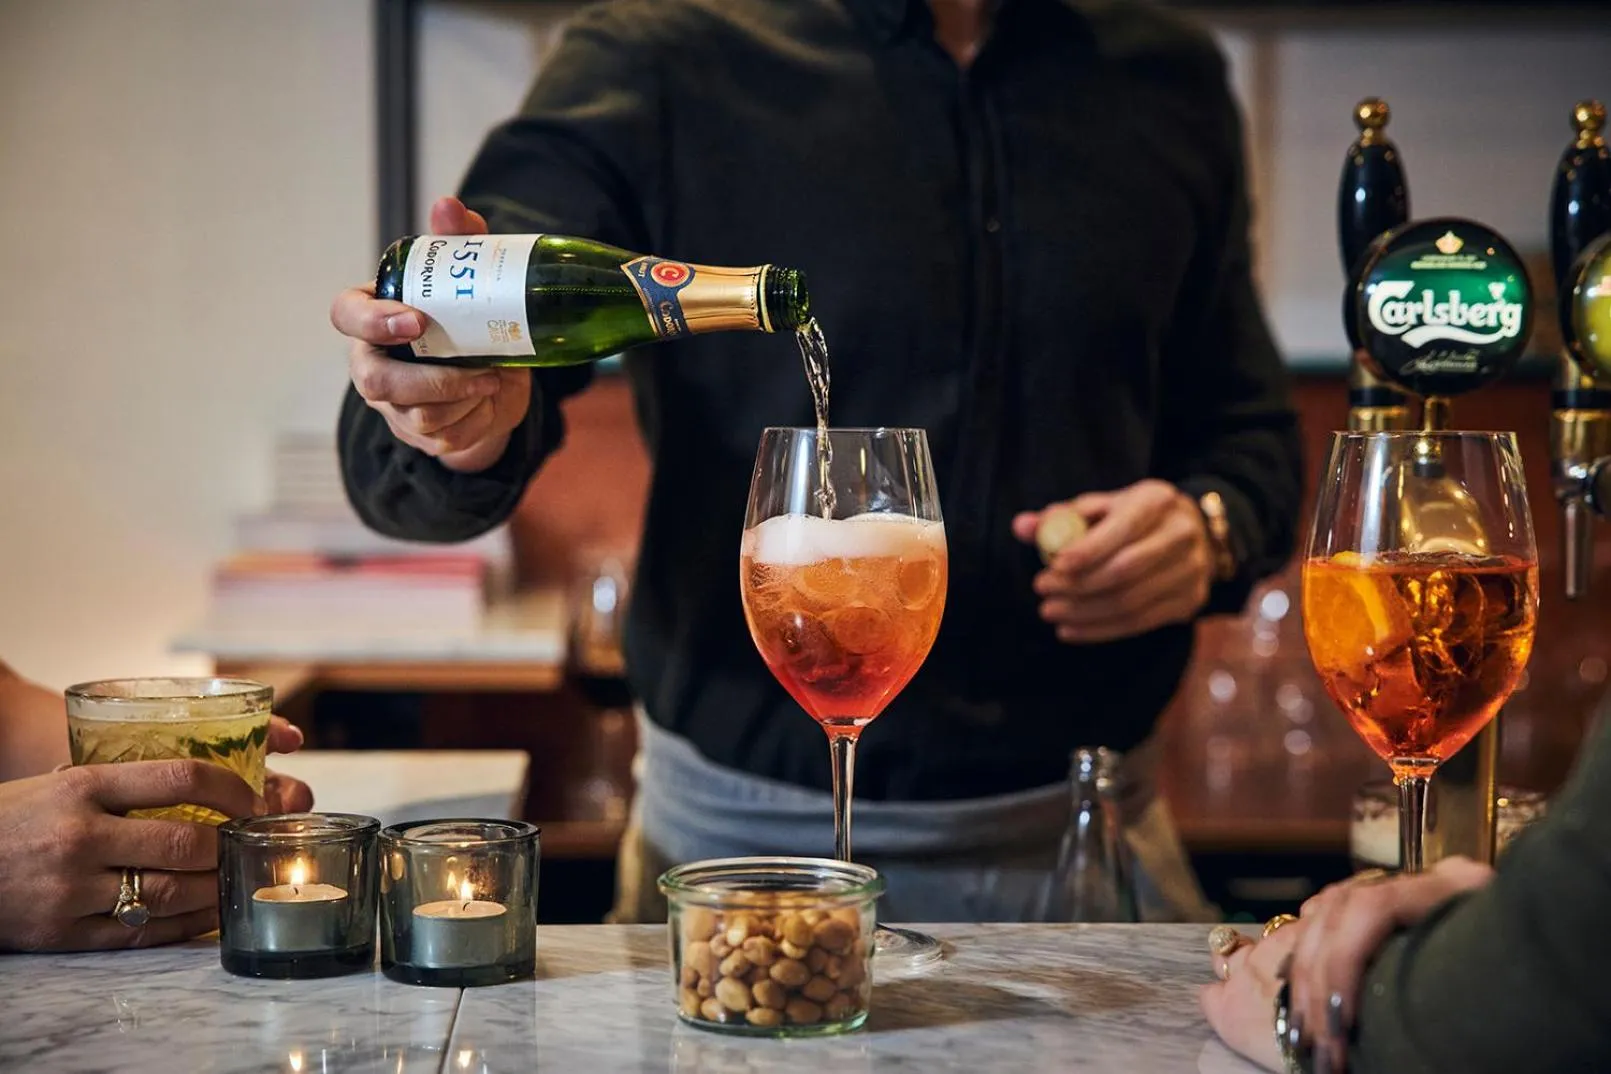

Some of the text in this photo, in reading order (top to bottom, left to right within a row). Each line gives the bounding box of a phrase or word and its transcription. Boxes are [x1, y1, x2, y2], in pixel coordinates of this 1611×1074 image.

[421, 240, 447, 298] CODORNIU
[450, 240, 483, 299] 1551
[660, 266, 679, 278] C
[1368, 280, 1523, 348] Carlsberg
